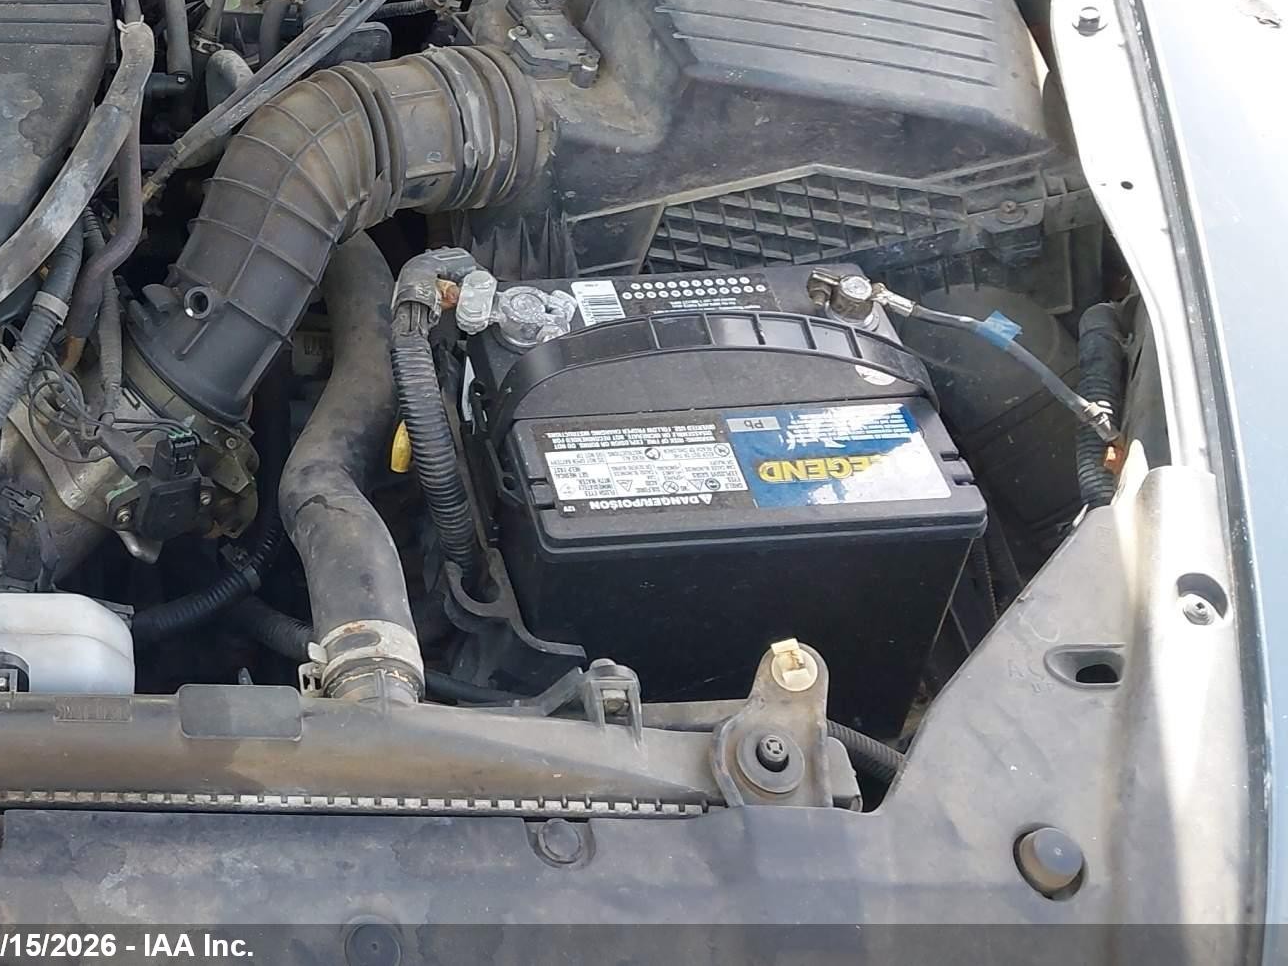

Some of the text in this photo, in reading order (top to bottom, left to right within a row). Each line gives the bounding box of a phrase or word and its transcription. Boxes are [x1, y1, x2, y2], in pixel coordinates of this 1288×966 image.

[743, 420, 764, 429] Pb
[758, 455, 888, 482] EGEND
[589, 496, 699, 510] DANGER/POISON
